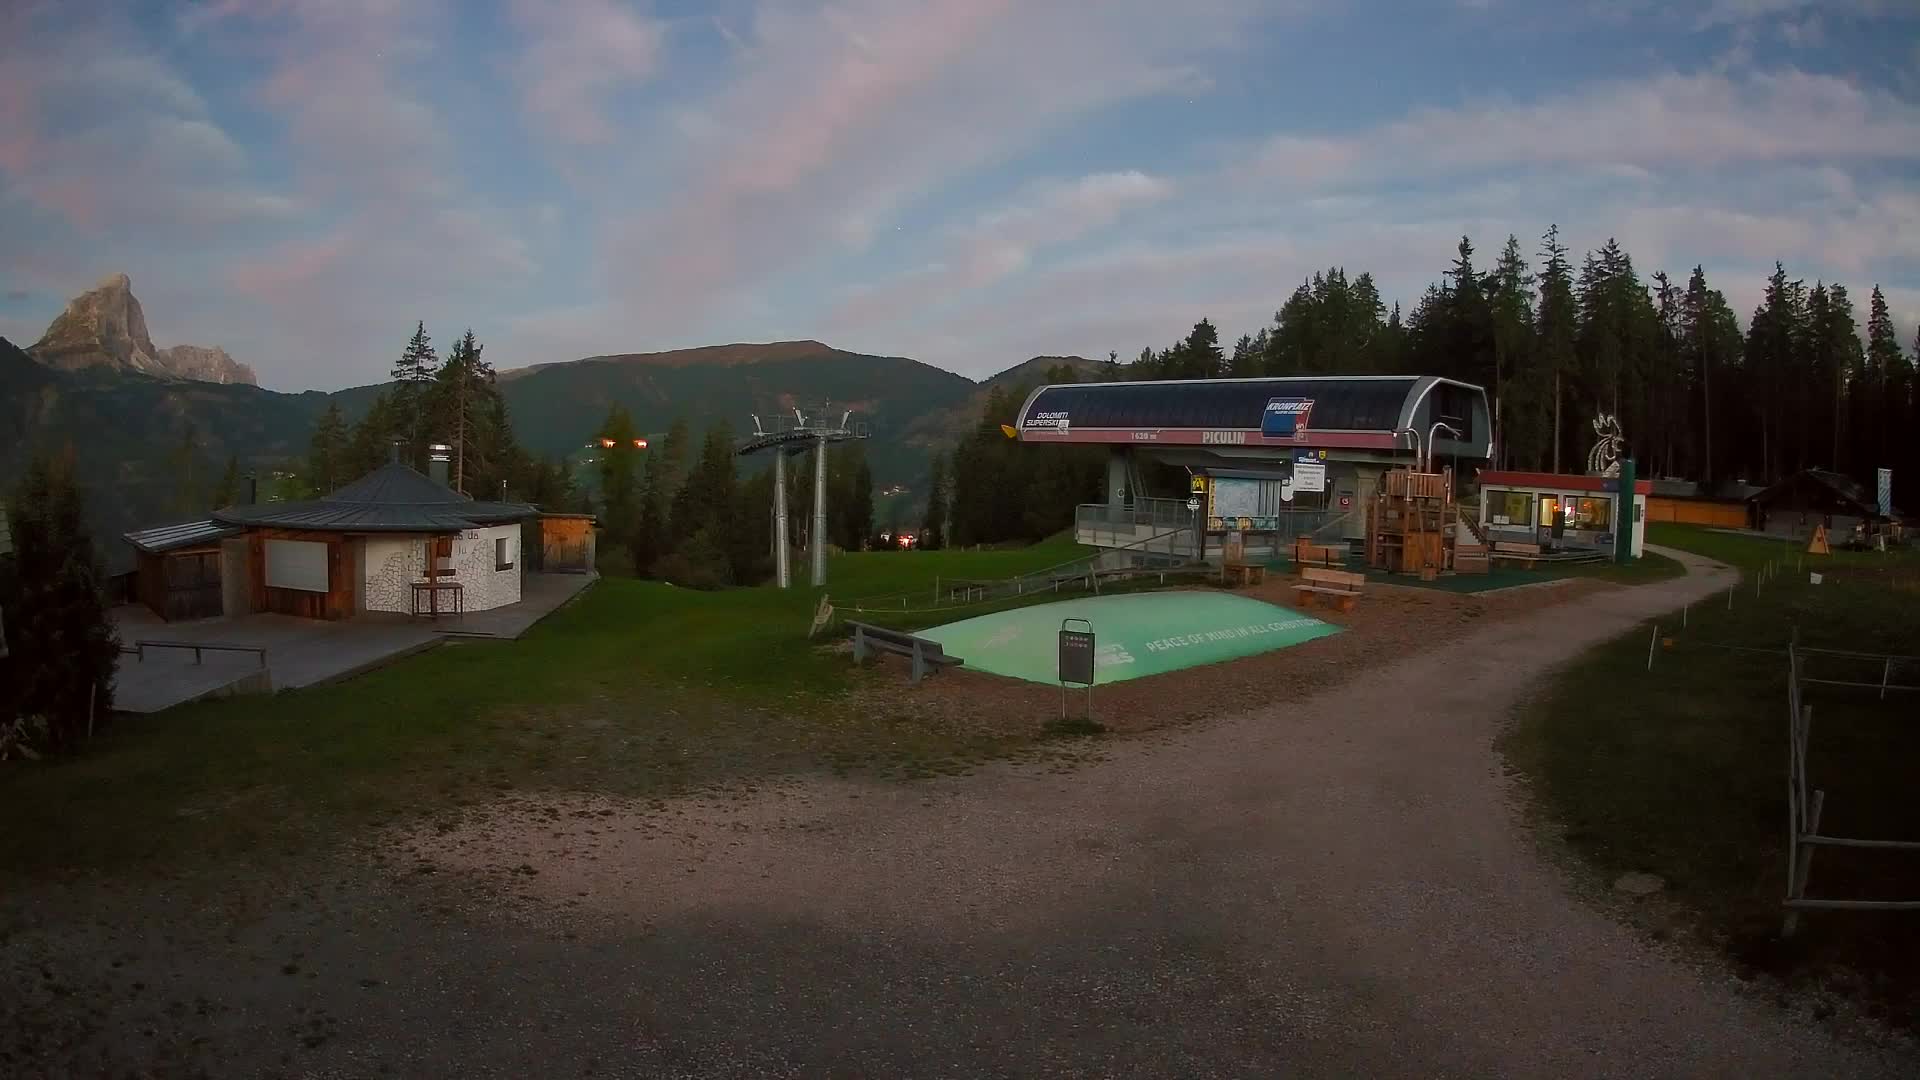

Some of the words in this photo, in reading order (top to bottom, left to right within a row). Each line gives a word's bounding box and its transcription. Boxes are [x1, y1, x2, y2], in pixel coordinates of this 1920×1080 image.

[1267, 402, 1312, 411] KRONPLATZ
[1202, 431, 1246, 444] PICULIN
[1145, 635, 1189, 653] PEACE
[1187, 631, 1204, 644] OF
